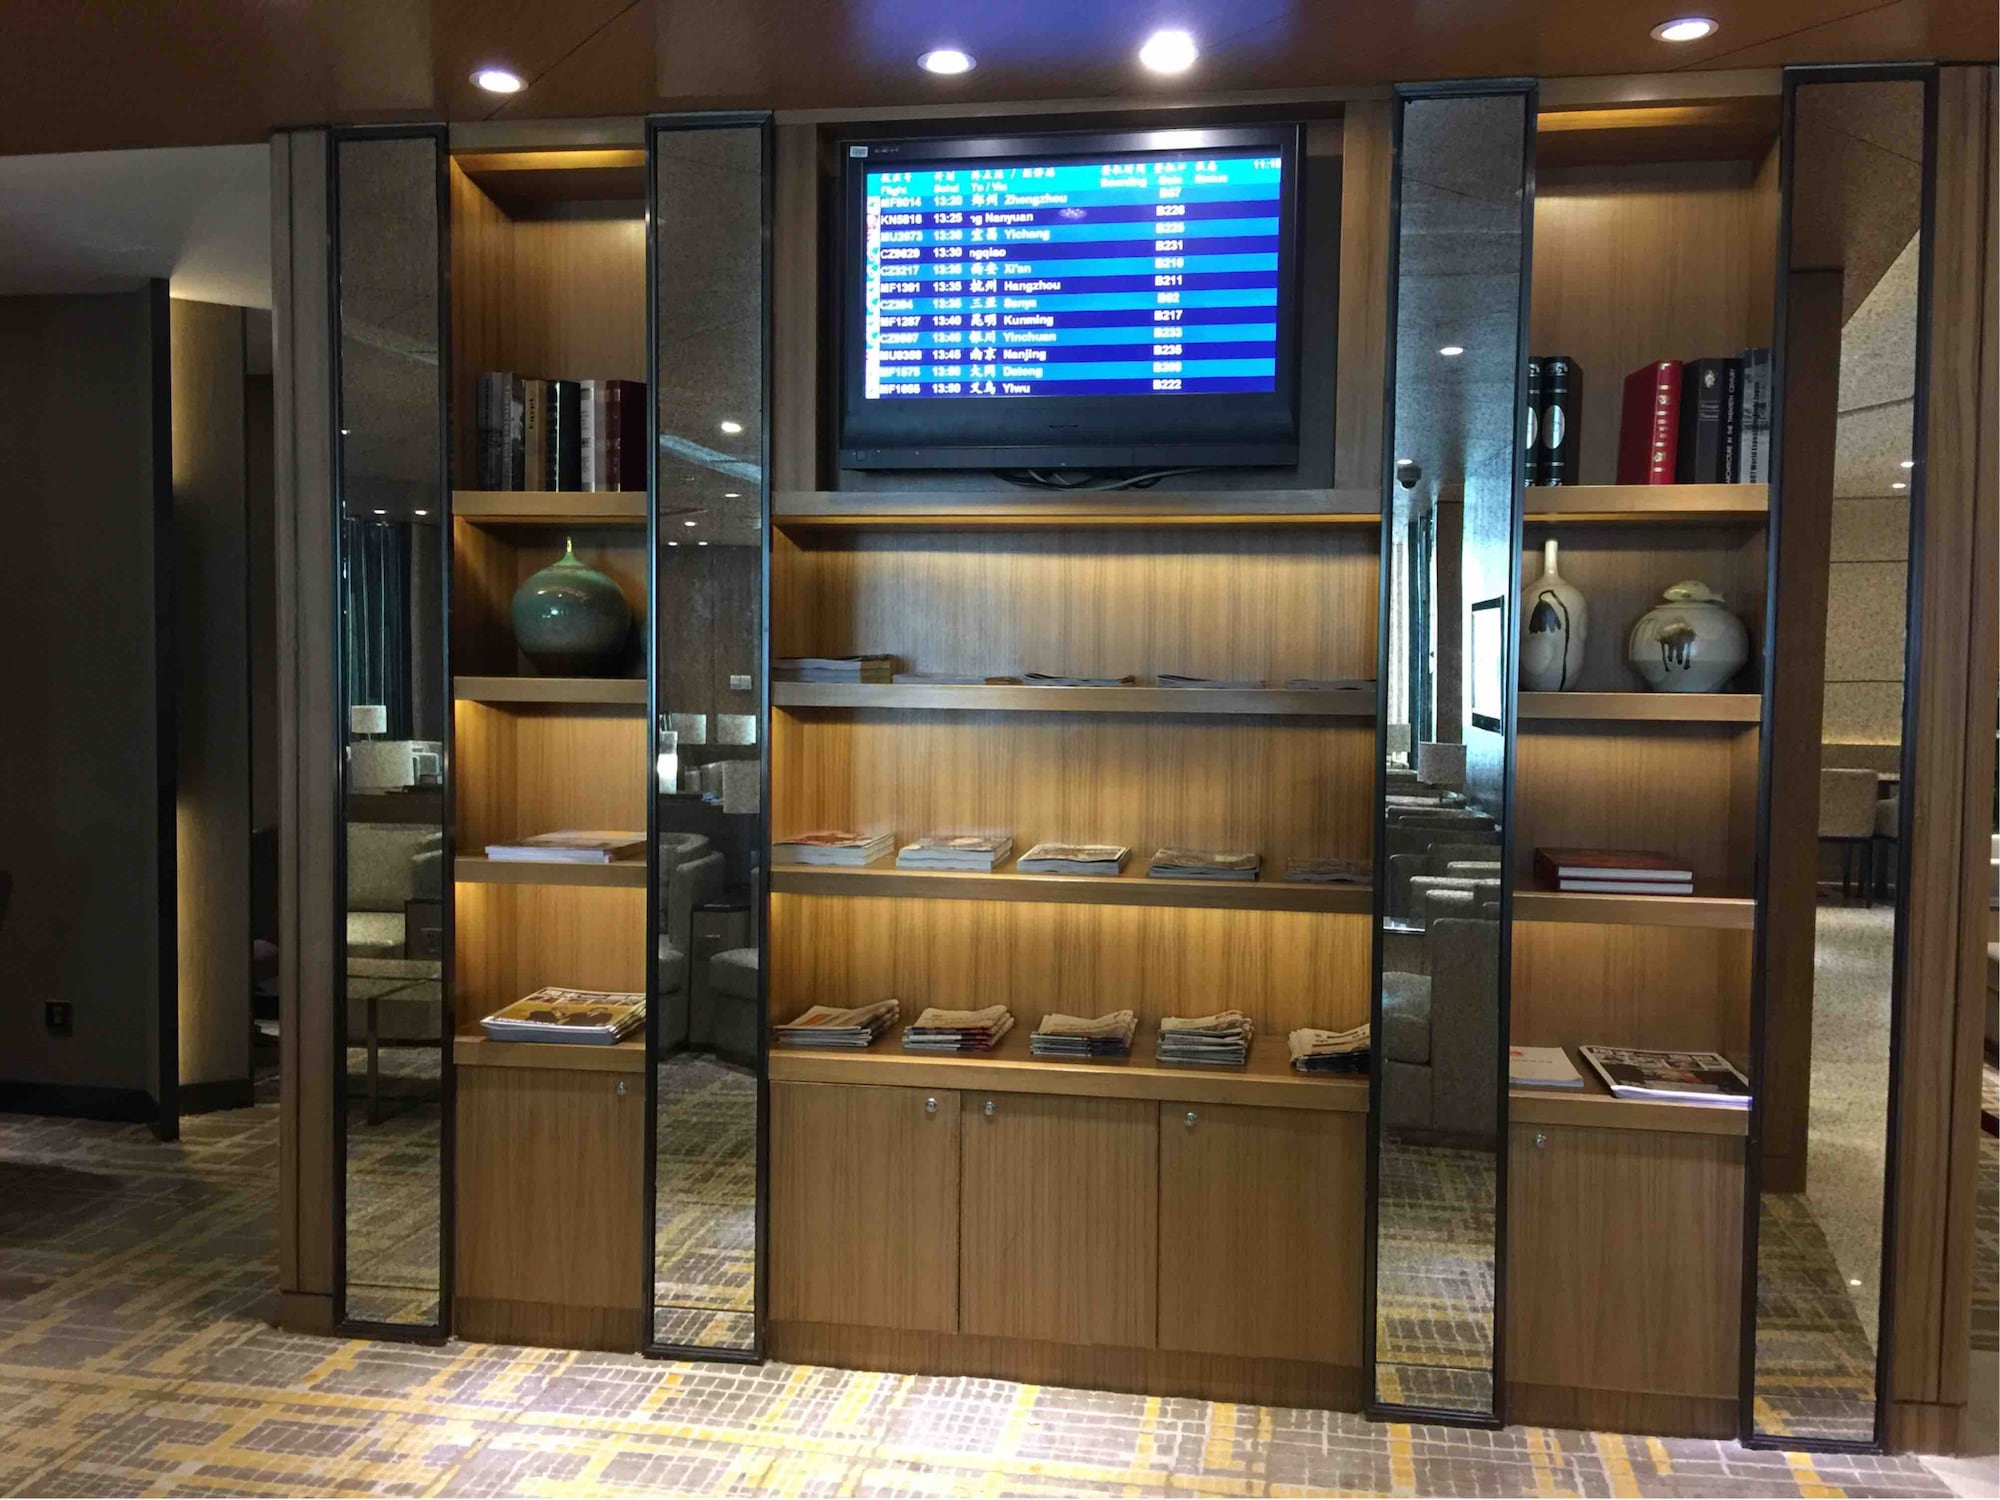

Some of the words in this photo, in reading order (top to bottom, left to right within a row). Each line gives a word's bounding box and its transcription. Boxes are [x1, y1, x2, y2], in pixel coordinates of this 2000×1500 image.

[934, 195, 963, 206] 13:20
[934, 213, 963, 224] 13:25
[985, 212, 1034, 225] Nanyuan
[1004, 228, 1050, 241] Yichang
[933, 247, 962, 258] 13:30
[969, 247, 1006, 260] ngqiao
[1155, 240, 1183, 251] B231
[933, 281, 962, 292] 13:35
[970, 279, 997, 292] 杭州
[1004, 281, 1061, 293] Hangzhou
[1154, 275, 1182, 286] B211
[933, 316, 962, 327] 13:40
[971, 313, 997, 326] 昆明
[1003, 315, 1054, 327] Kunming
[1154, 310, 1183, 321] B217
[1003, 332, 1056, 343] Yinchuan
[933, 349, 961, 360] 13:45
[970, 347, 997, 361] 南京
[1003, 350, 1046, 361] Nanjing
[932, 383, 961, 394] 13:50
[1002, 384, 1031, 394] Yiwu
[1153, 379, 1181, 390] B222
[1728, 368, 1736, 393] CENTURY
[1750, 453, 1758, 471] World
